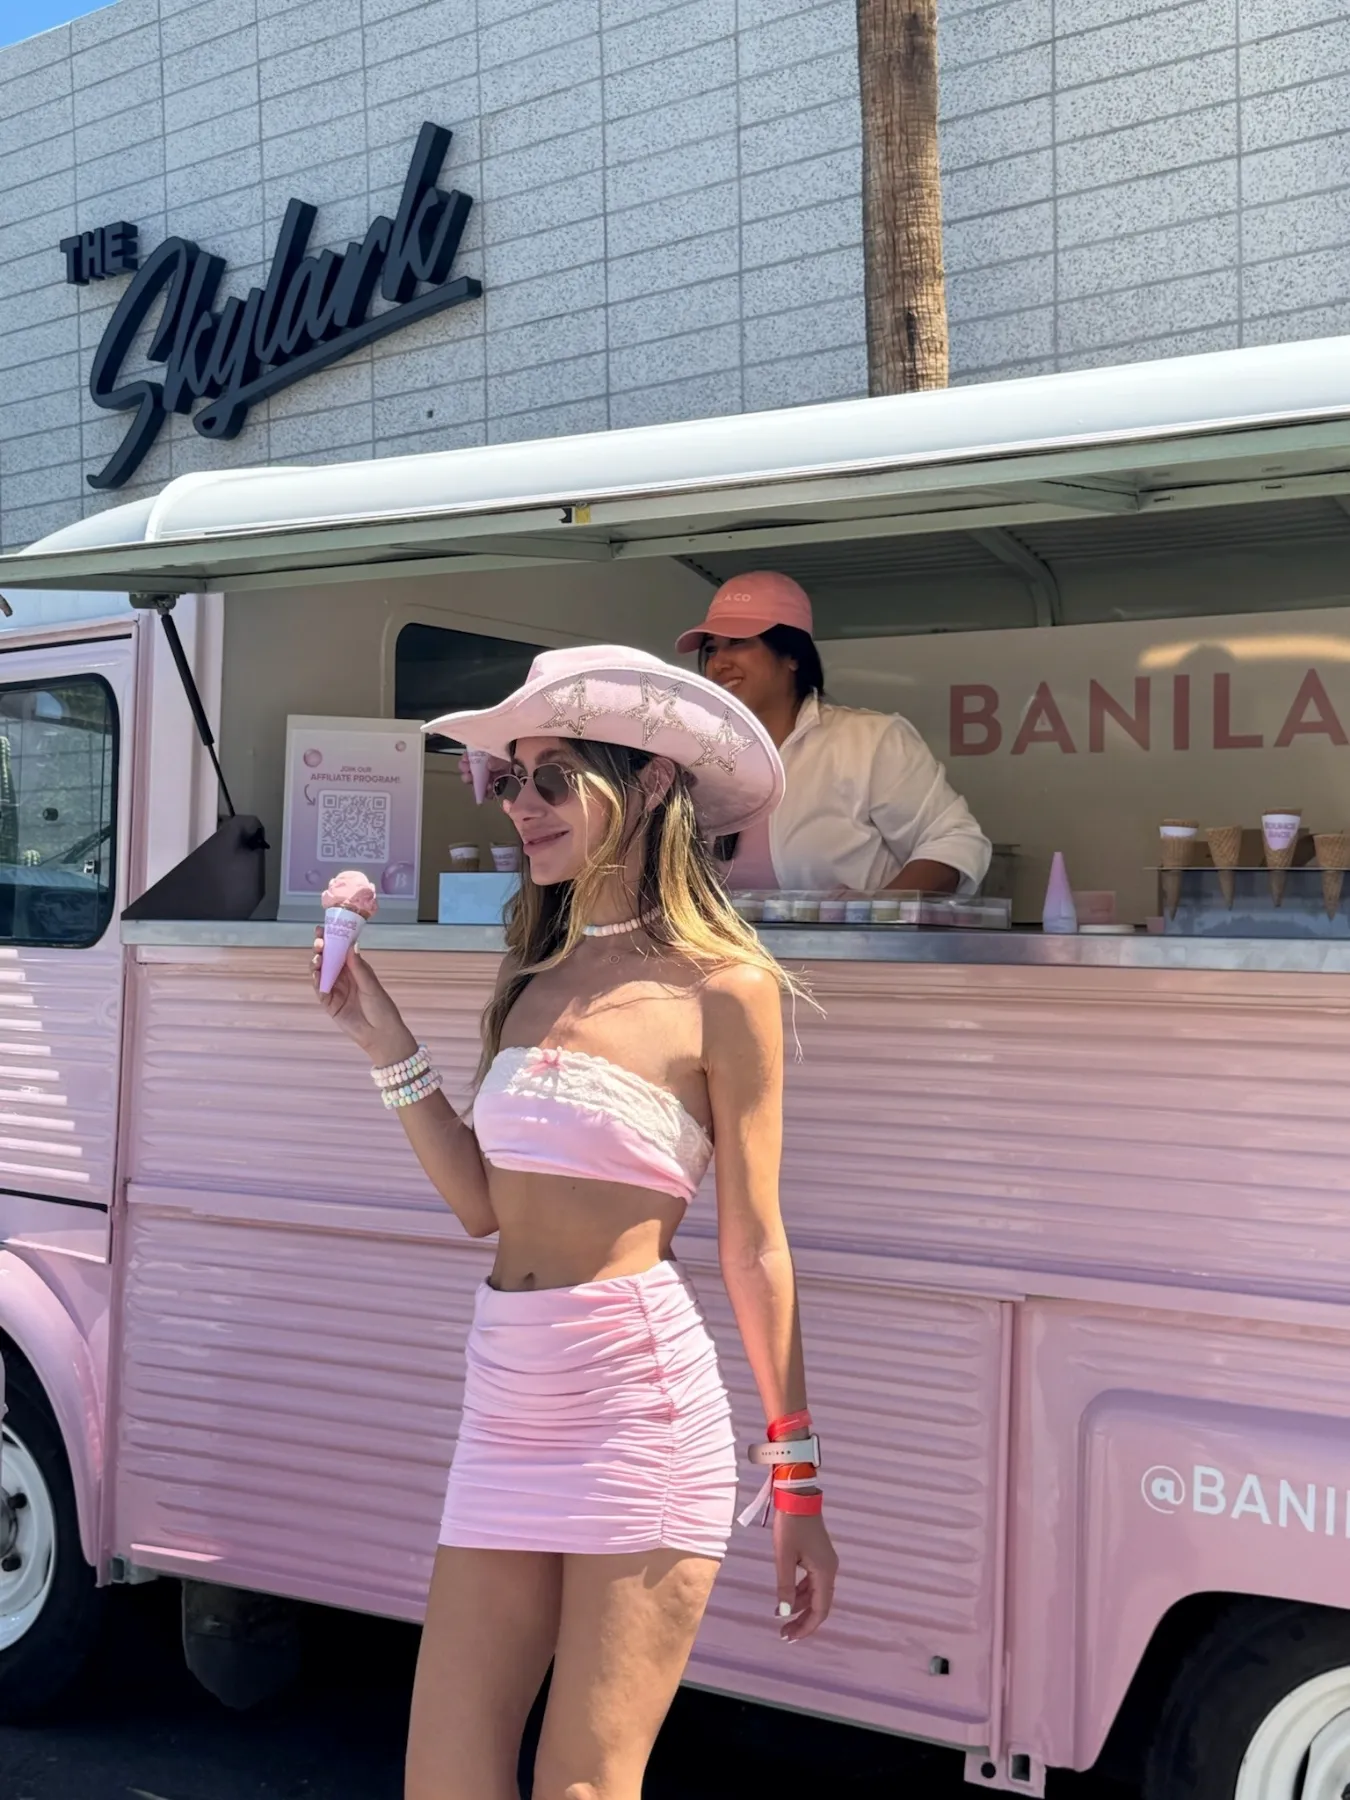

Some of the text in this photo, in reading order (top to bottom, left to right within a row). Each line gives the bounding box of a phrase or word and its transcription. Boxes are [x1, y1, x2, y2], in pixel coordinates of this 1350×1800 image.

[60, 220, 138, 286] THE
[87, 121, 482, 489] Skylark
[949, 667, 1349, 757] BANILA
[310, 773, 402, 784] AFFILIATE PROGRAM!
[1141, 1464, 1350, 1539] @BANI
